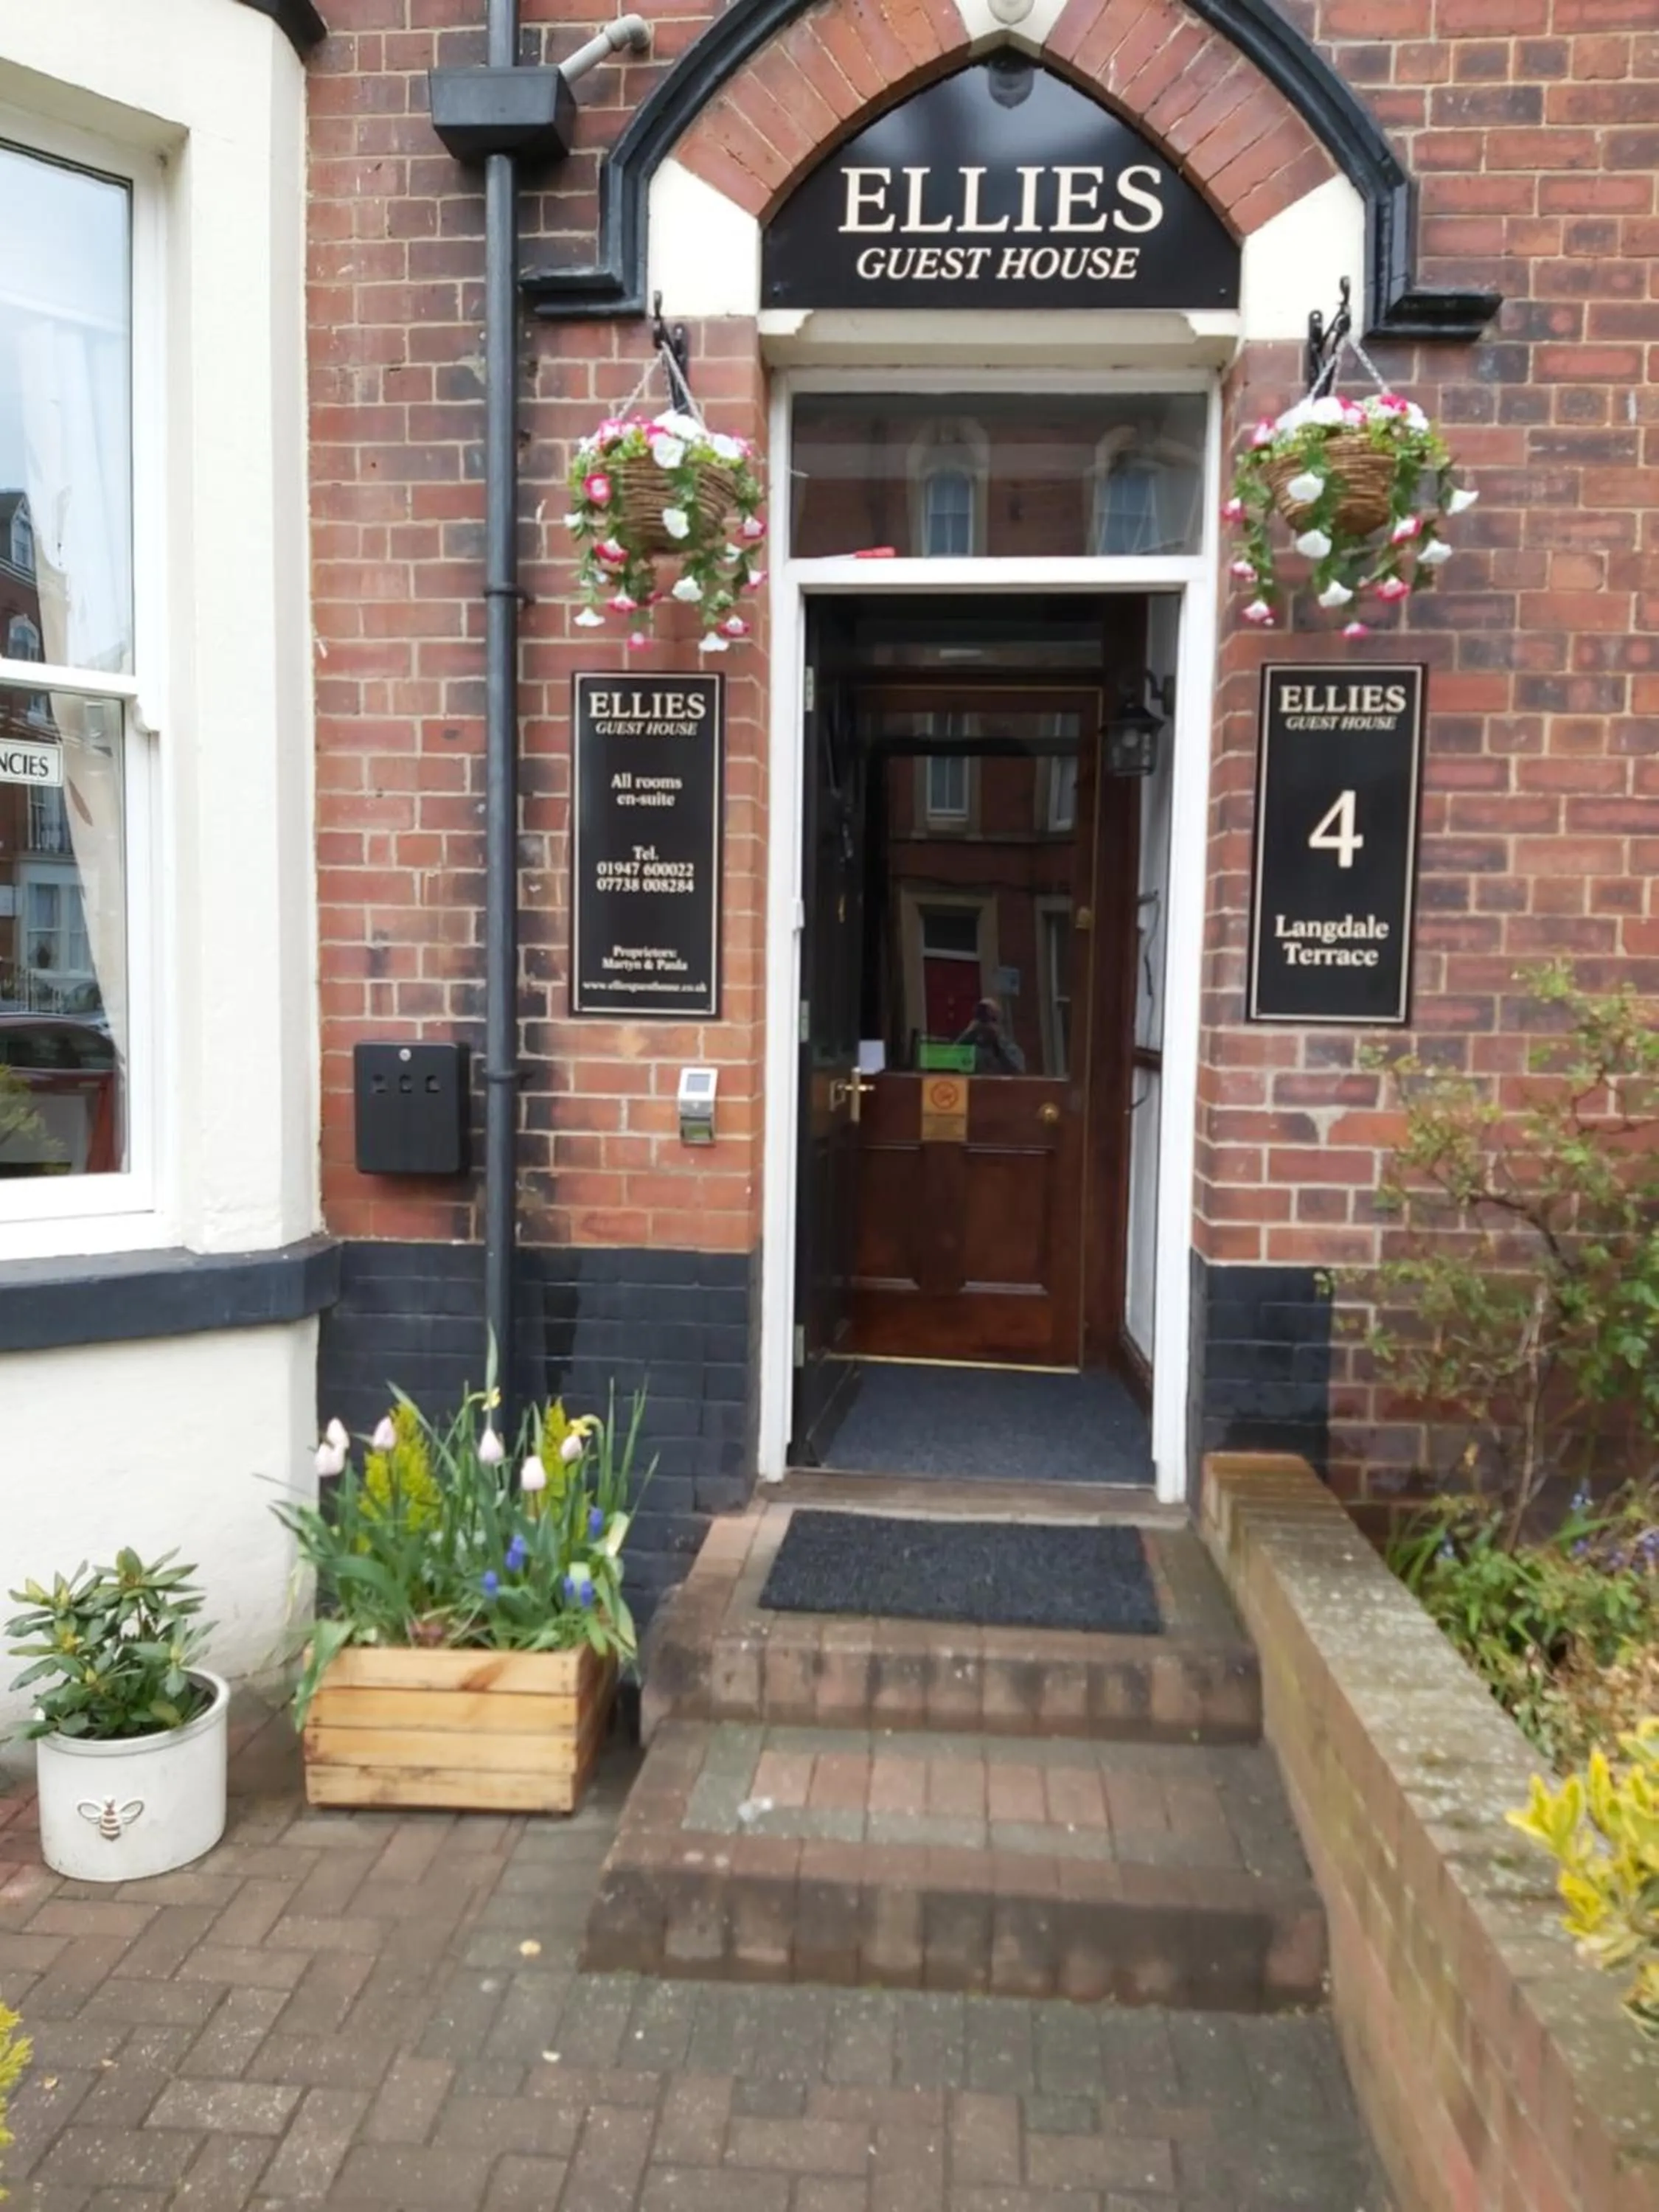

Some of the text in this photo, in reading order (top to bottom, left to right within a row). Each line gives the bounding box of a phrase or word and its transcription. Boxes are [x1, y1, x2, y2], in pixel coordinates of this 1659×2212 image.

[838, 165, 1164, 234] ELLIES
[856, 248, 1140, 280] GUEST HOUSE
[589, 692, 706, 720] ELLIES
[1280, 685, 1407, 714] ELLIES
[595, 721, 698, 736] GUEST HOUSE
[1285, 715, 1397, 731] GUEST HOUSE
[611, 773, 683, 790] All rooms
[616, 791, 676, 807] en-suite
[1308, 790, 1364, 869] 4
[632, 845, 659, 861] Tel.
[597, 861, 641, 876] 01947
[1275, 914, 1391, 944] Langdale
[1282, 942, 1380, 967] Terrace
